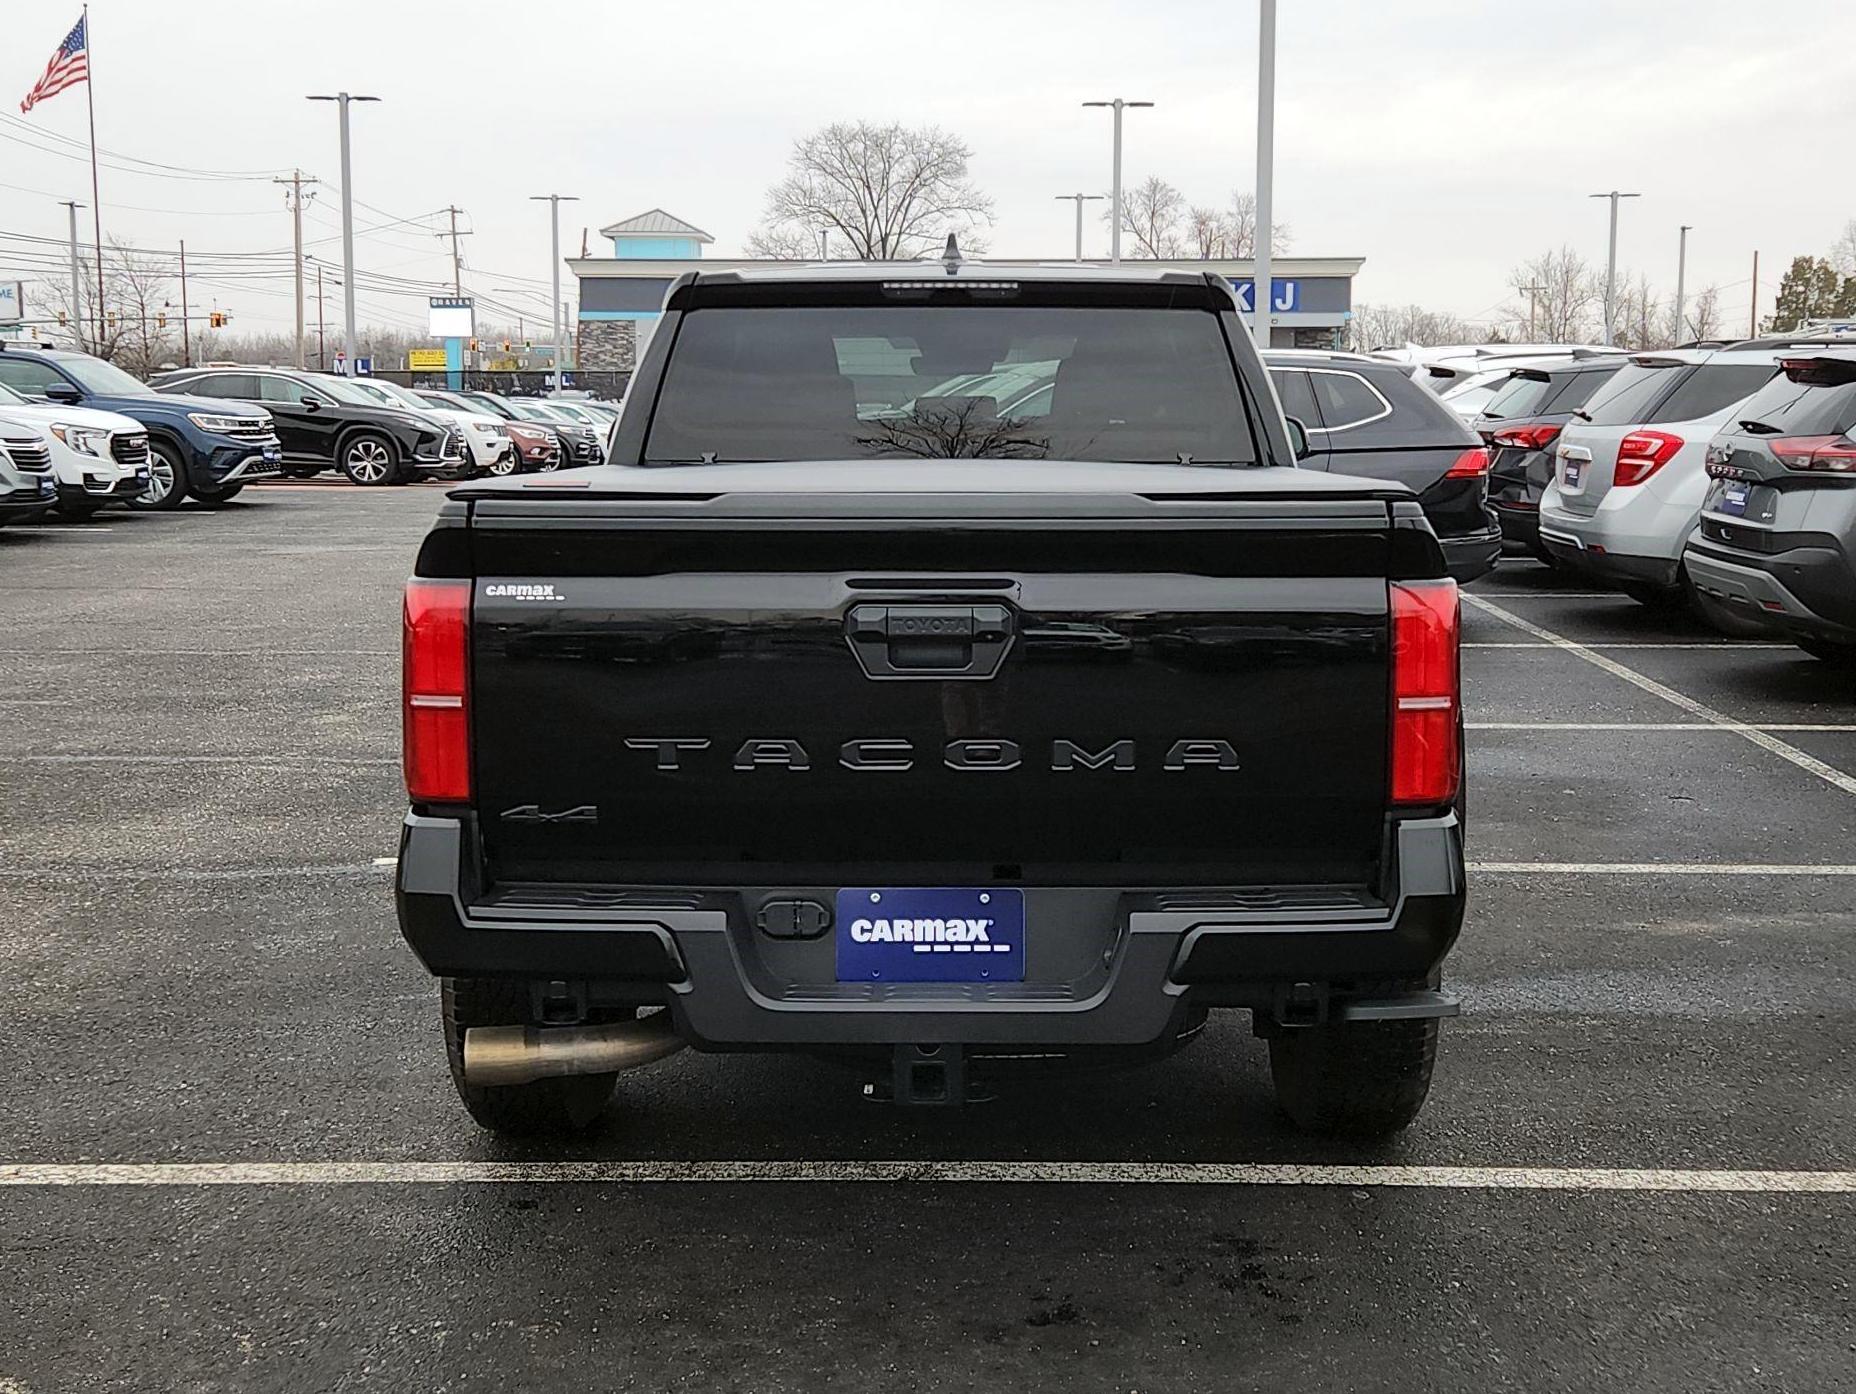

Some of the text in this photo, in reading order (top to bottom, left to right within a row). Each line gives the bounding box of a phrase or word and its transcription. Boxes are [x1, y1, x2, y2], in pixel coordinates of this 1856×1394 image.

[1231, 283, 1251, 311] K
[1275, 282, 1294, 311] J
[333, 359, 346, 373] M
[357, 359, 368, 373] L
[561, 375, 570, 386] L
[889, 616, 971, 633] TOYOTA
[623, 738, 1240, 771] TACOMA
